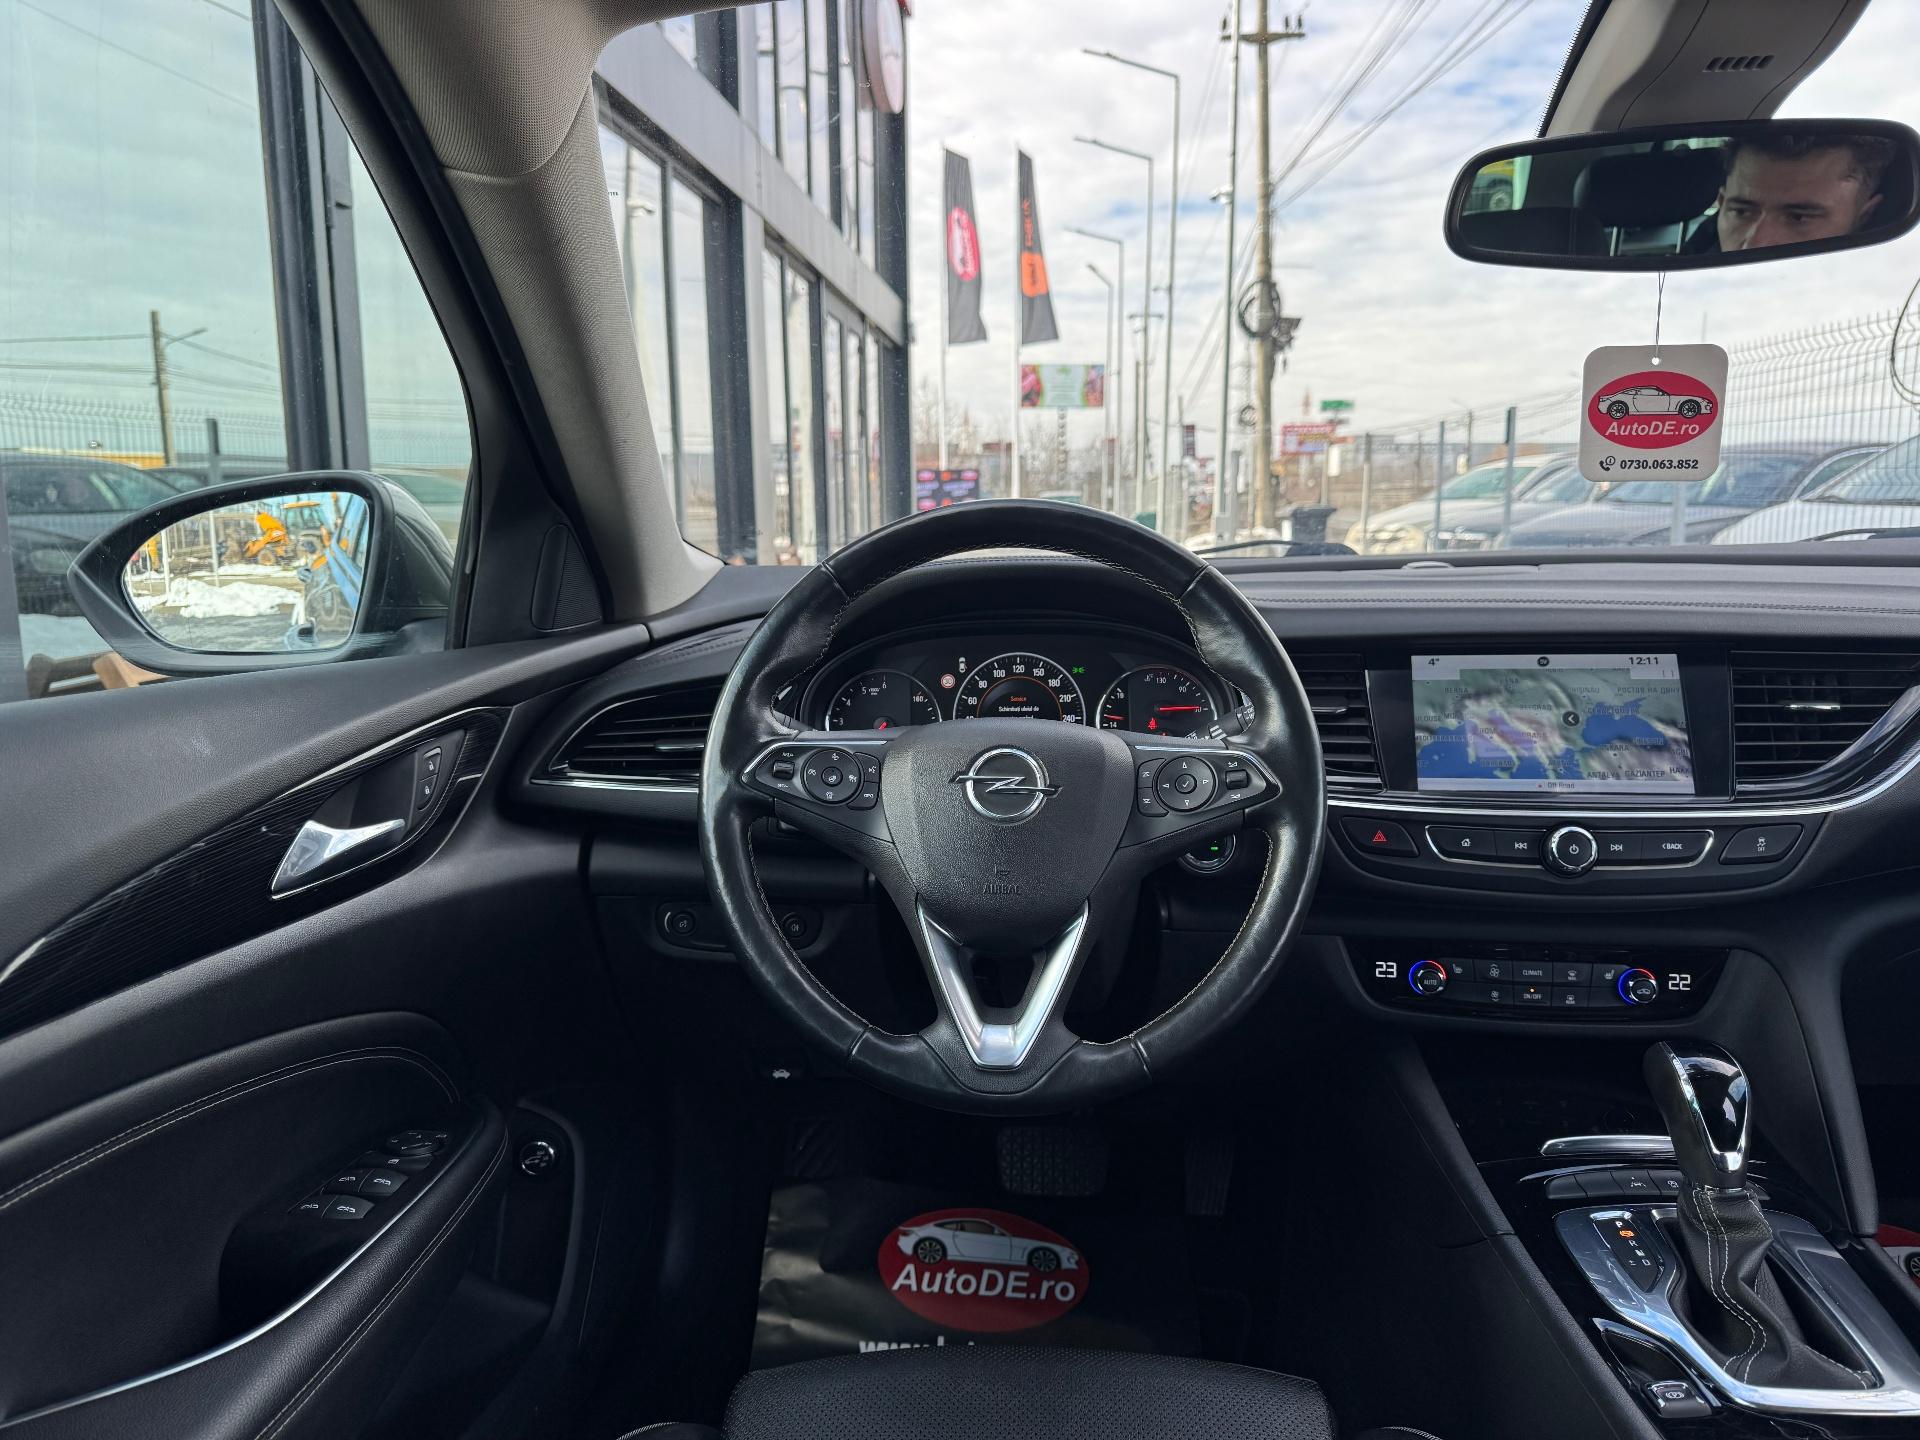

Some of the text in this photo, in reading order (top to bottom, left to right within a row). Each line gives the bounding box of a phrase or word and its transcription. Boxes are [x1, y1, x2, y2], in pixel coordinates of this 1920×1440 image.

[1605, 421, 1700, 436] AutoDE.ro
[1620, 459, 1699, 470] 0730.063.852
[1629, 656, 1659, 665] 12:11
[1012, 664, 1025, 673] 120
[1033, 668, 1045, 677] 150
[993, 669, 1006, 678] 100
[882, 681, 887, 689] 6
[978, 680, 988, 689] 80
[1048, 679, 1061, 687] 180
[862, 687, 867, 695] 5
[1178, 685, 1187, 693] 90
[846, 699, 851, 707] 4
[967, 696, 977, 705] 60
[1059, 694, 1072, 703] 210
[839, 718, 844, 726] 3
[1062, 714, 1076, 723] 240
[1109, 721, 1117, 729] 14
[1375, 961, 1397, 978] 23
[1668, 973, 1691, 991] 22
[891, 1263, 1076, 1302] AutoDE.ro
